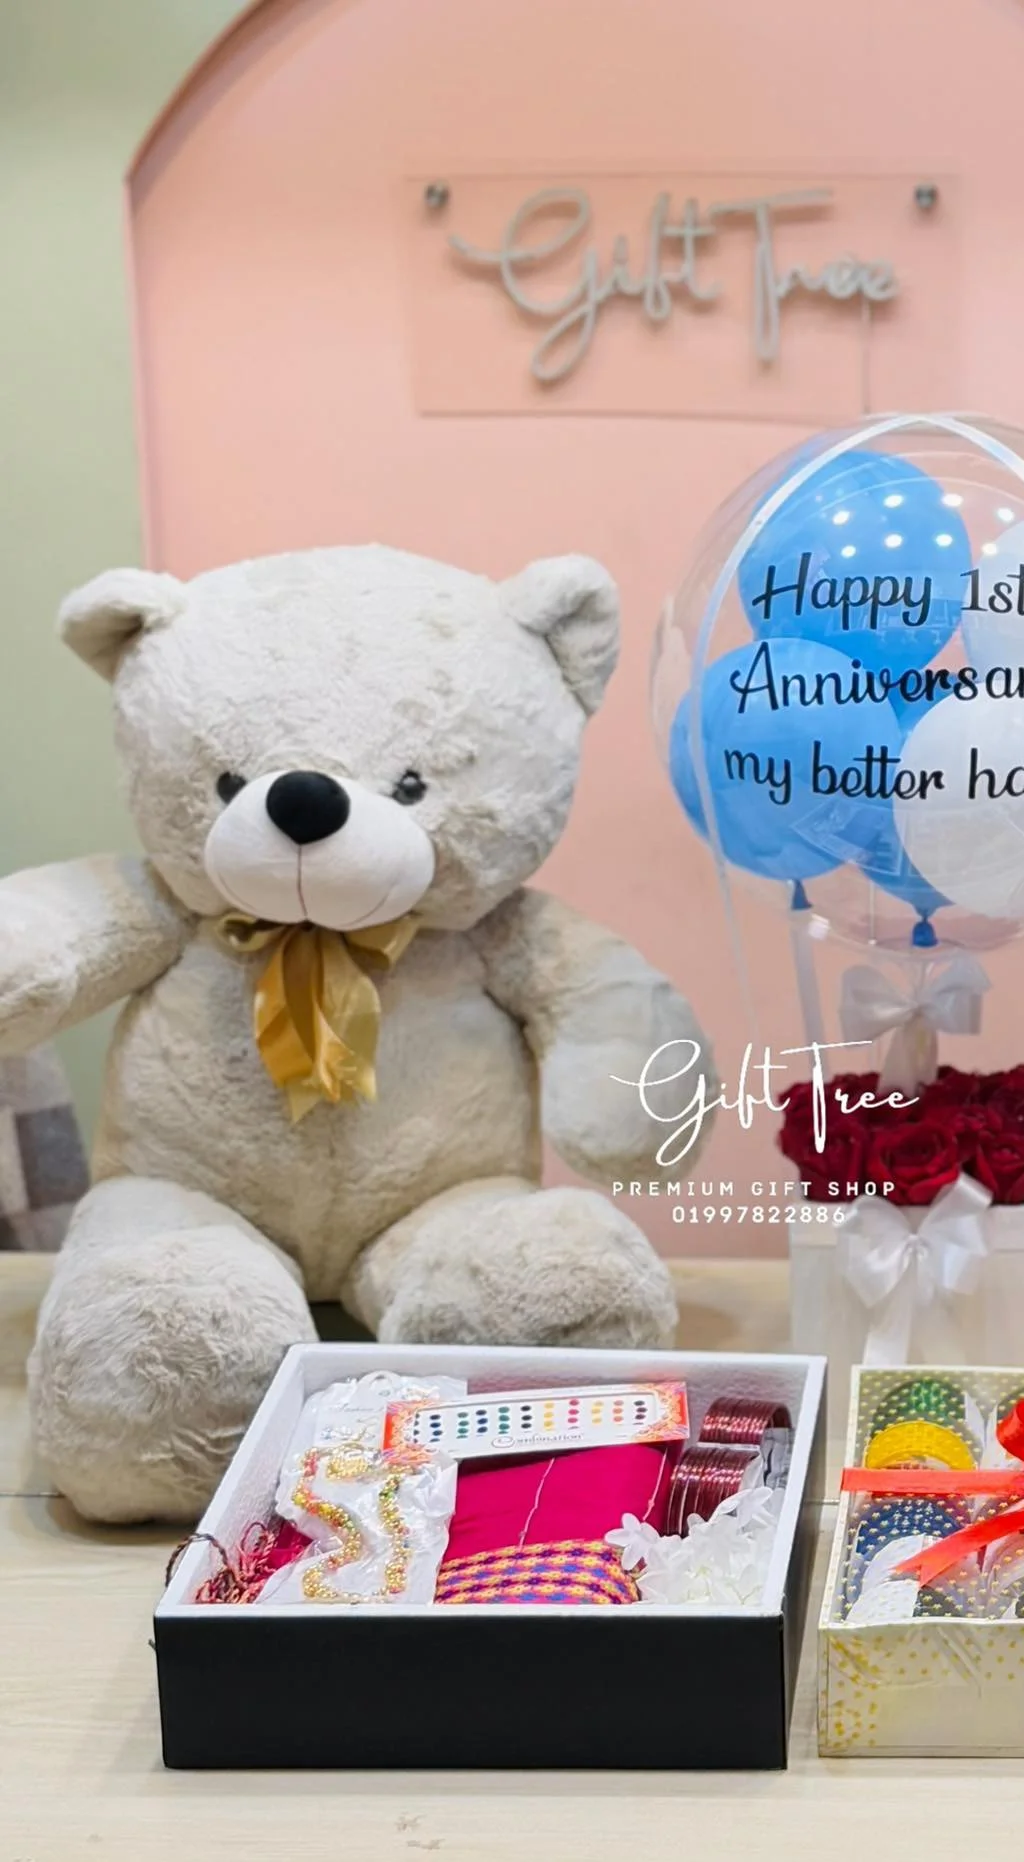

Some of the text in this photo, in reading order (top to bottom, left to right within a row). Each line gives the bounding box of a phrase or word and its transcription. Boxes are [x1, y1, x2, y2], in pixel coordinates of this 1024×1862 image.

[449, 188, 897, 381] Gift Tree
[752, 552, 932, 630] Happy
[724, 749, 791, 805] my
[812, 741, 945, 800] better
